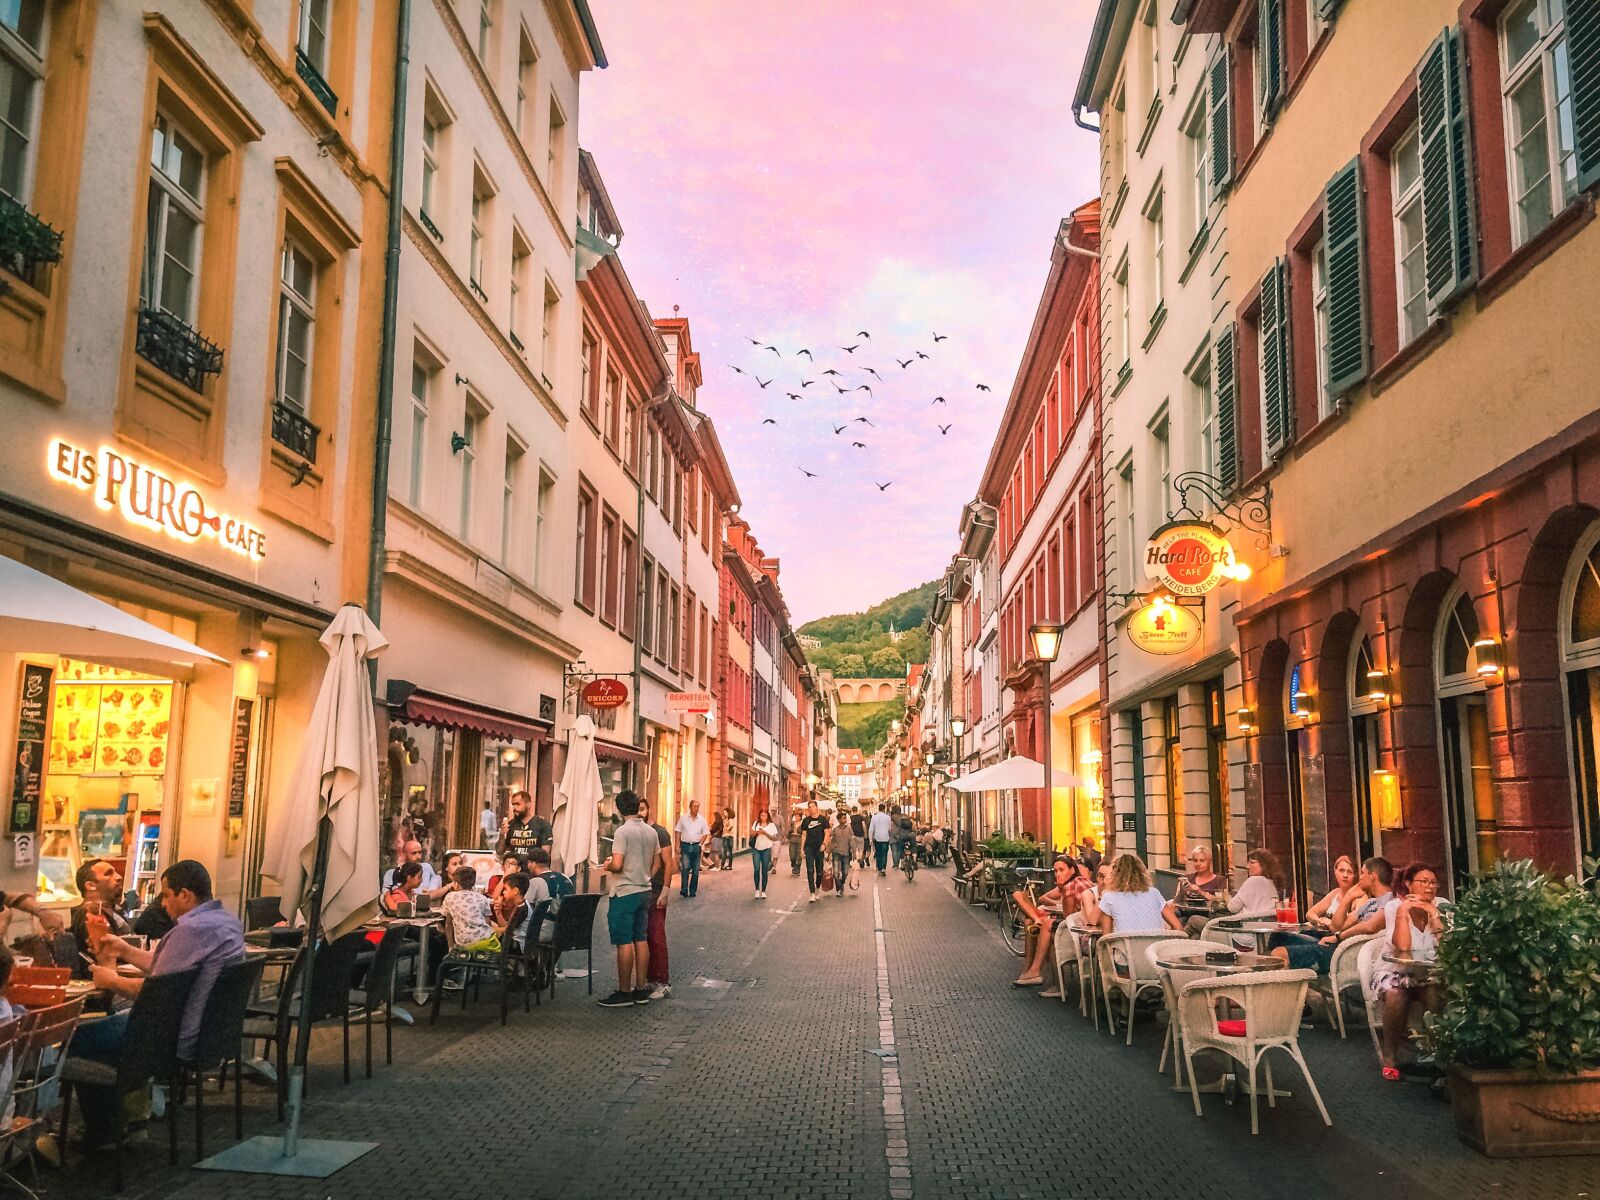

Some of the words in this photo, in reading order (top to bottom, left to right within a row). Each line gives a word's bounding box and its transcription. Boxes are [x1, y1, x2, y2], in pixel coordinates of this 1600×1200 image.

[58, 443, 96, 485] EIS
[226, 520, 266, 557] CAFE
[1163, 536, 1176, 550] HELP
[1191, 532, 1215, 547] PLANET
[1147, 546, 1189, 565] Hard
[1190, 546, 1230, 566] Rock
[1180, 568, 1202, 576] CAFE
[1163, 574, 1219, 594] HEIDELBERG
[669, 693, 710, 701] BERNSTEIN
